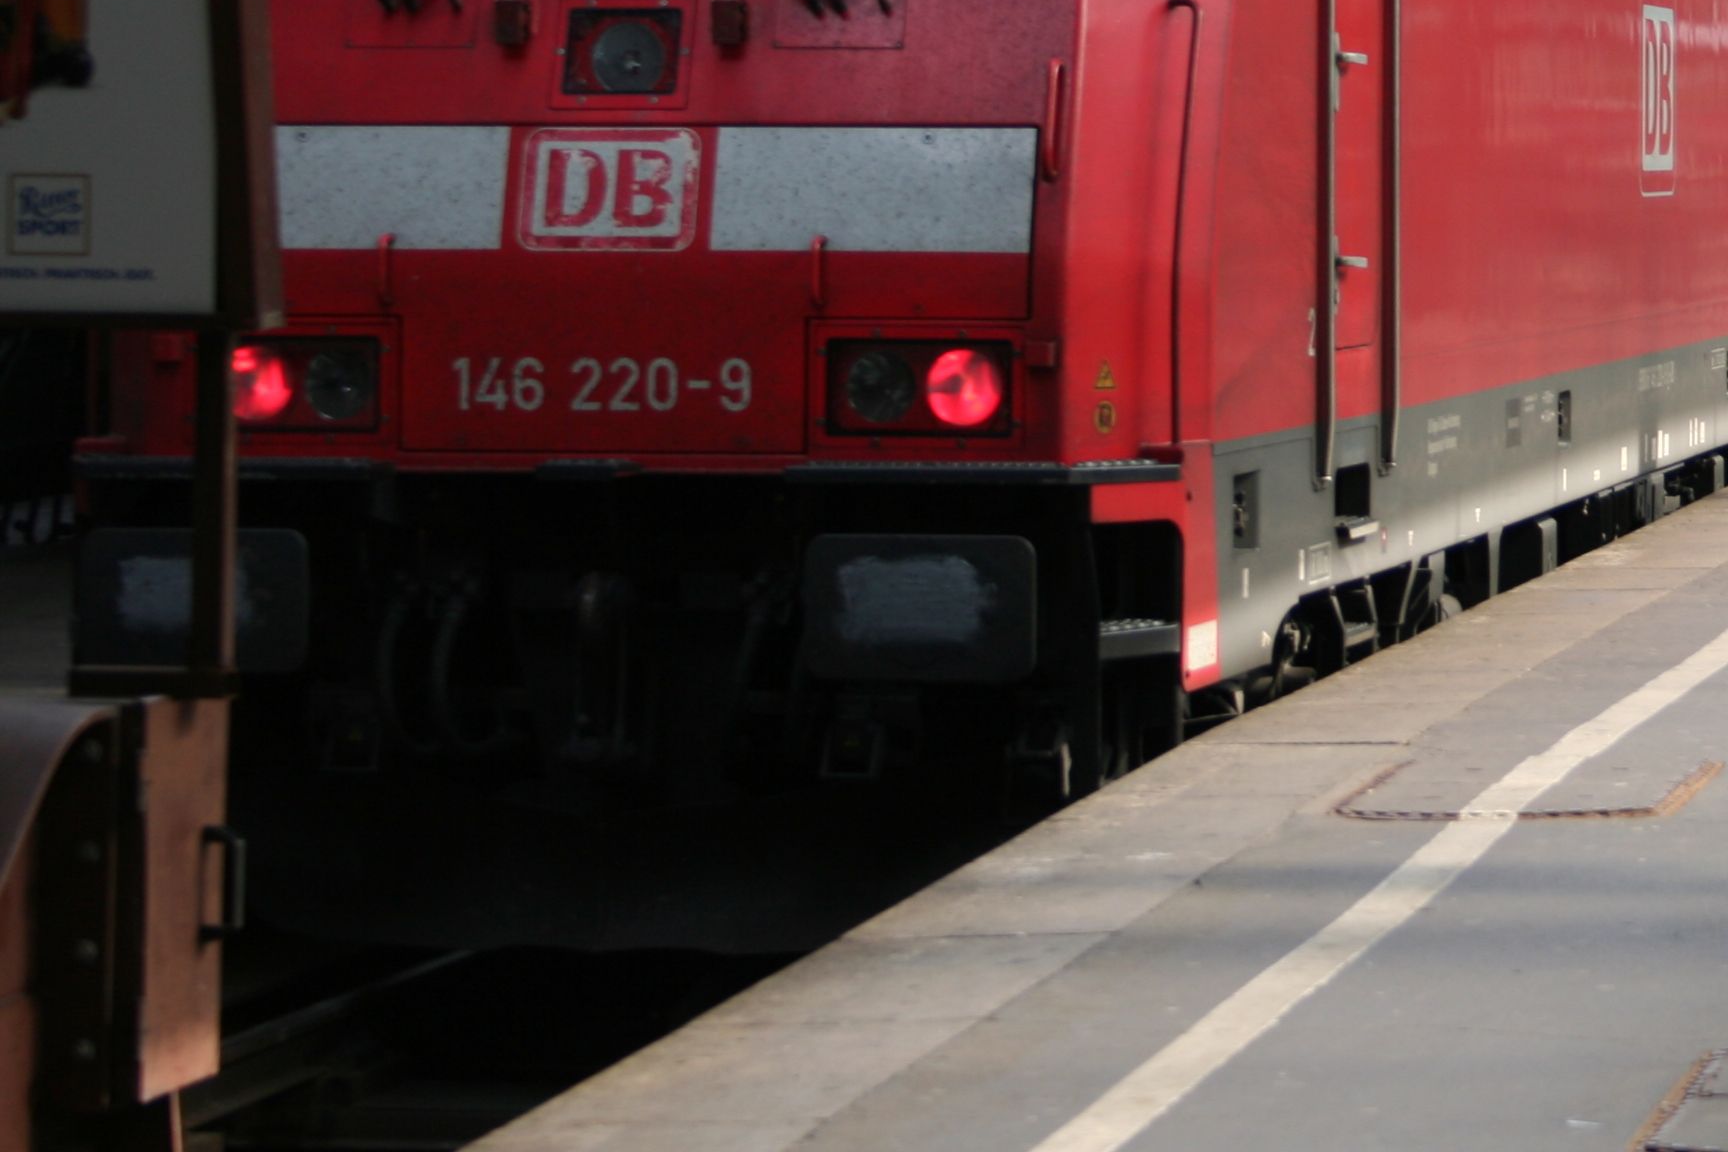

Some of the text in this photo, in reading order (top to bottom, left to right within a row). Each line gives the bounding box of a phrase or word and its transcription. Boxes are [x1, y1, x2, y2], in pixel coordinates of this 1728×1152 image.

[1643, 6, 1674, 170] DB
[538, 144, 680, 233] DB
[452, 355, 753, 412] 146 220-9
